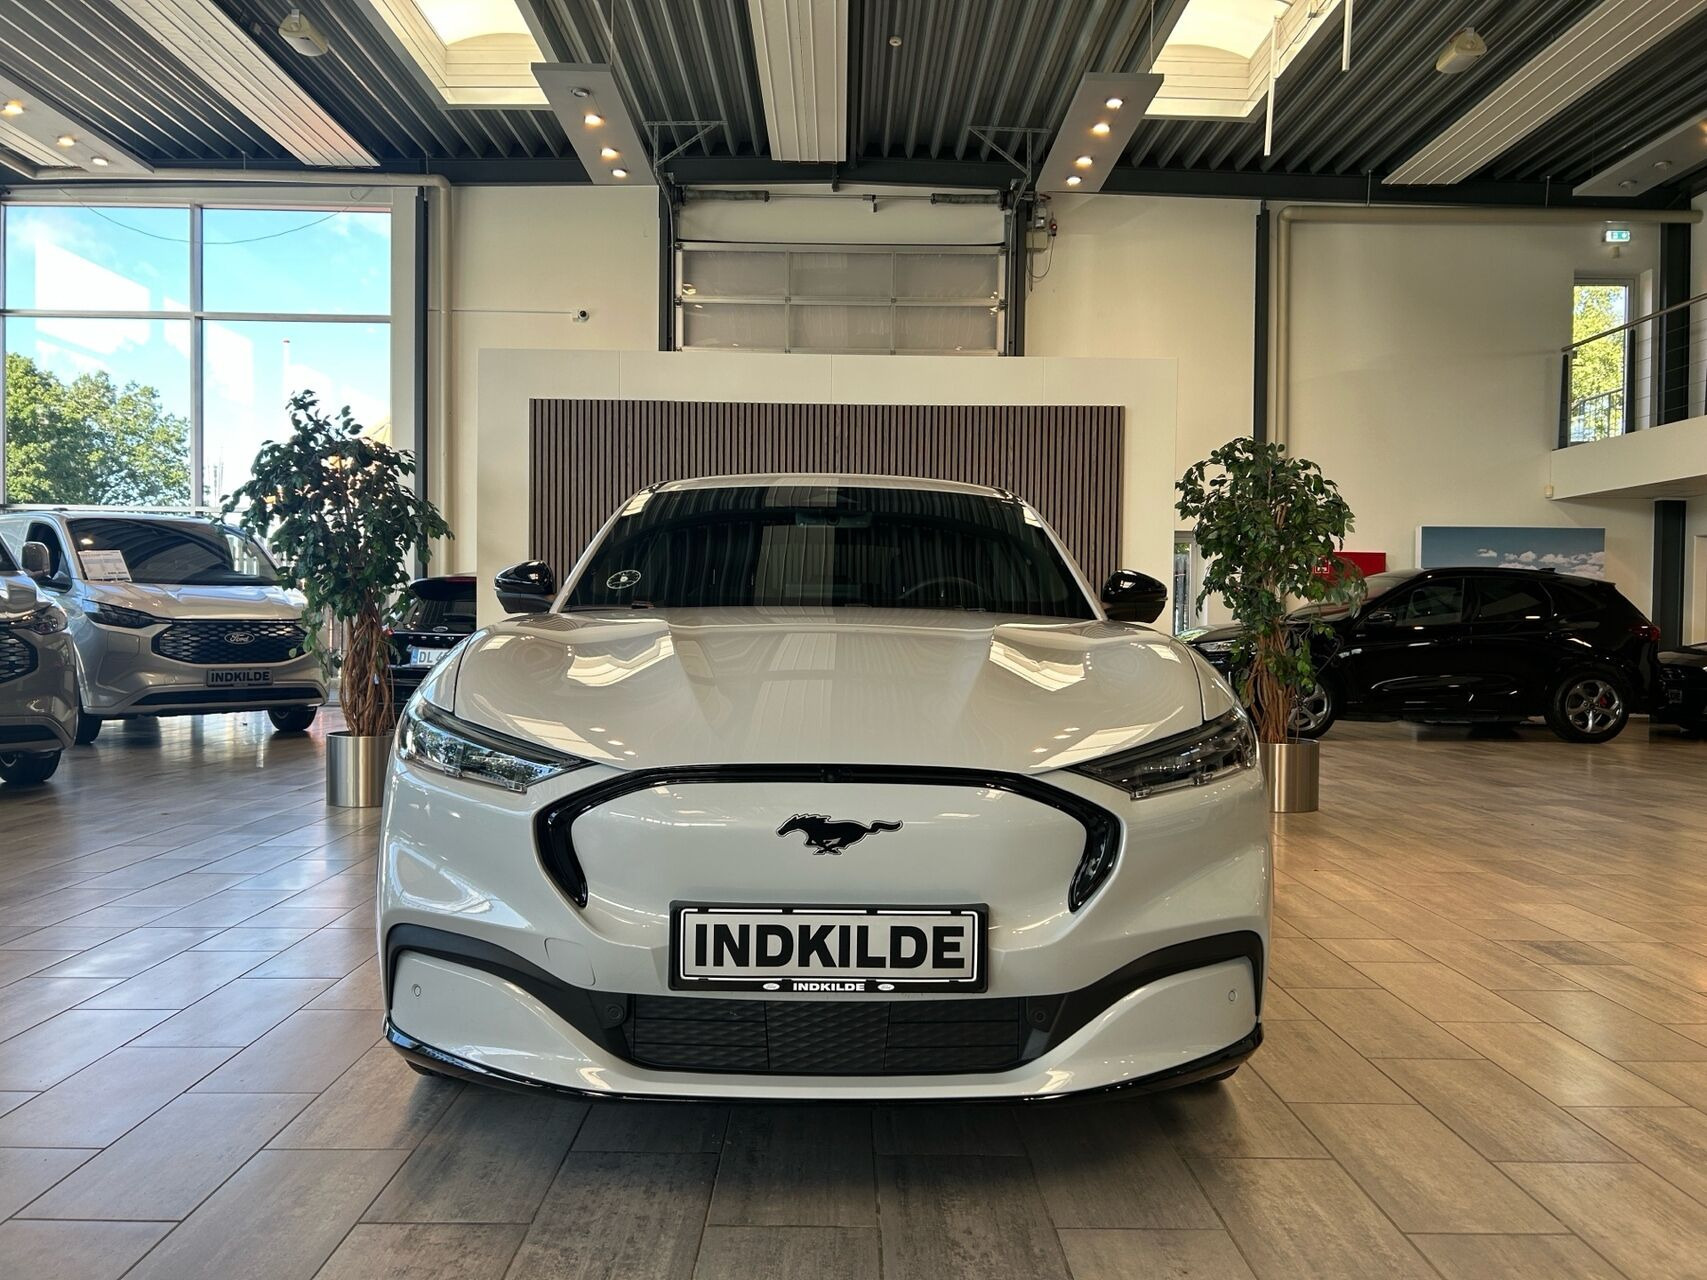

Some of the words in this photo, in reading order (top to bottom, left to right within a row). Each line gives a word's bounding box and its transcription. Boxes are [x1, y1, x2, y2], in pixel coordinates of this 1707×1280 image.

[419, 651, 433, 663] DL
[211, 671, 270, 683] INDKILDE
[695, 923, 965, 969] INDKILDE
[793, 982, 865, 991] INDKILDE
